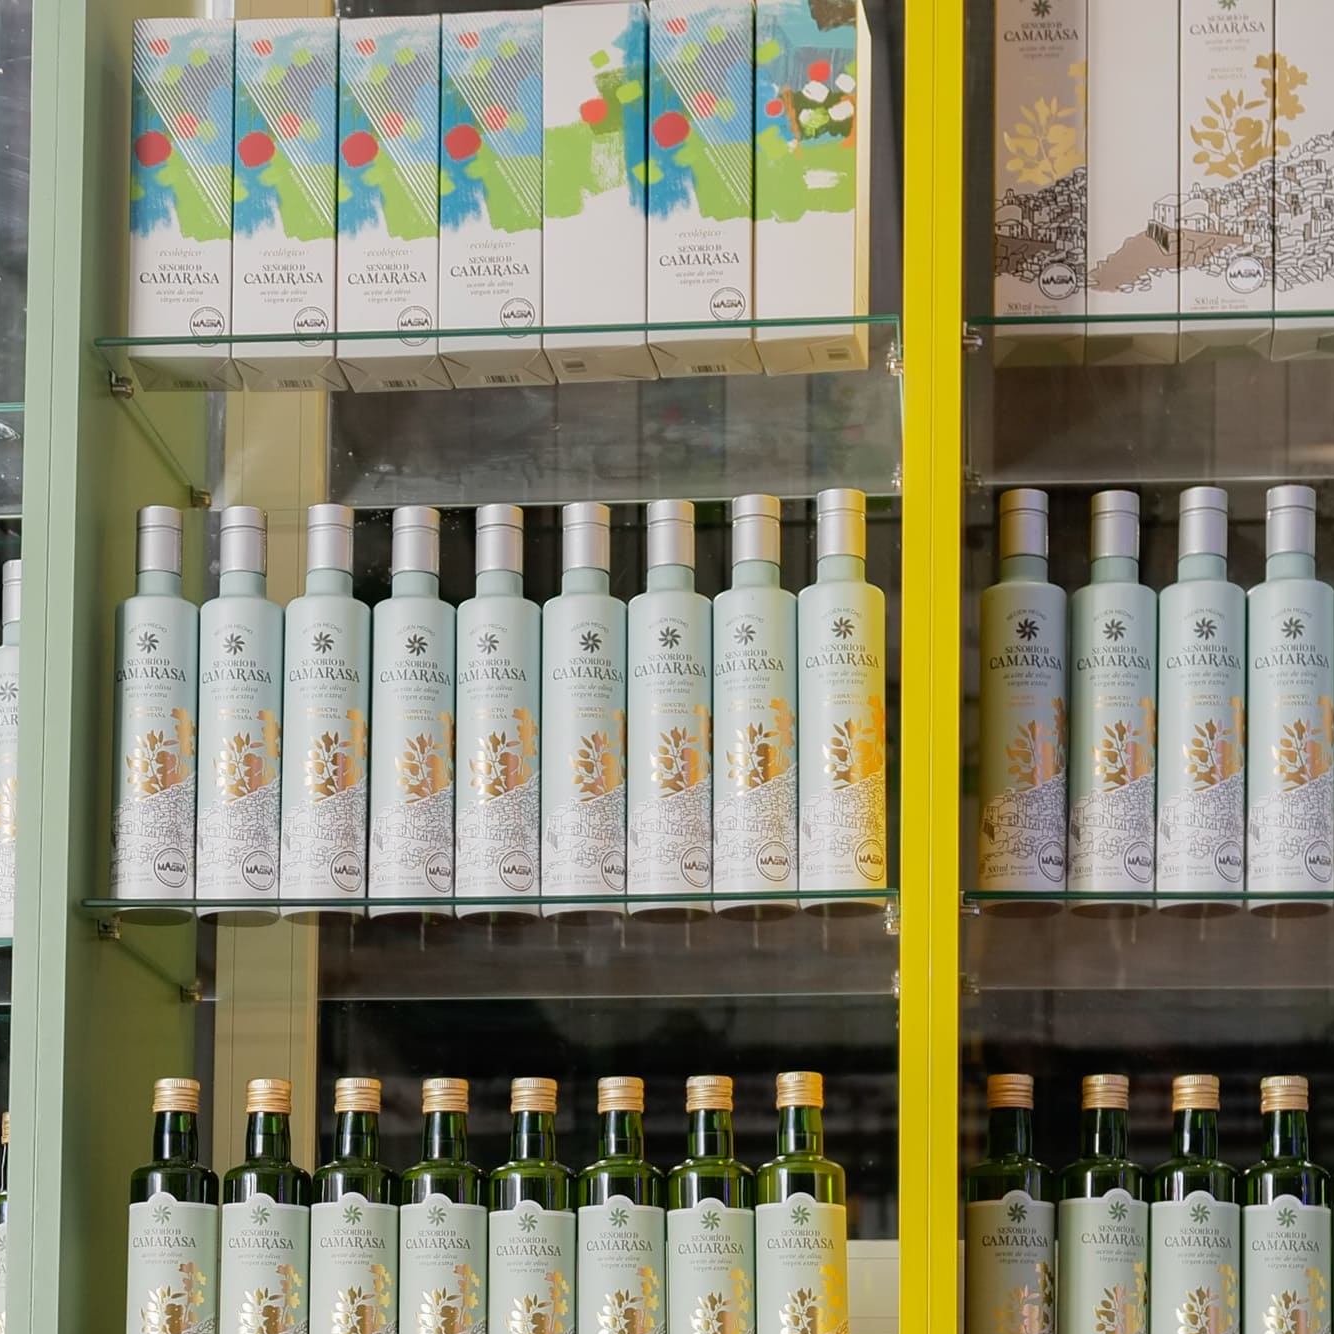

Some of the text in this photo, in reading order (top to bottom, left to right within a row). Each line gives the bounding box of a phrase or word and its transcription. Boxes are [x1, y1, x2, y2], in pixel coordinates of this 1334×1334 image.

[1003, 28, 1079, 42] CAMARASA
[1189, 21, 1265, 36] CAMARASA
[659, 252, 739, 268] CAMARASA
[139, 271, 219, 285] CAMARASA
[243, 271, 324, 284] CAMARASA
[347, 270, 427, 285] CAMARASA
[450, 263, 530, 278] CAMARASA
[805, 653, 880, 669] CAMARASA
[989, 654, 1062, 671] CAMARASA
[1077, 655, 1151, 672] CAMARASA
[1166, 654, 1241, 671] CAMARASA
[1254, 654, 1330, 671] CAMARASA
[202, 669, 272, 685] CAMARASA
[289, 668, 360, 684] CAMARASA
[380, 670, 451, 686] CAMARASA
[553, 668, 624, 683] CAMARASA
[633, 664, 707, 680] CAMARASA
[133, 1236, 196, 1249] CAMARASA
[228, 1238, 295, 1251] CAMARASA
[319, 1236, 385, 1250] CAMARASA
[405, 1237, 471, 1251] CAMARASA
[587, 1239, 653, 1253] CAMARASA
[767, 1237, 834, 1251] CAMARASA
[982, 1234, 1048, 1248] CAMARASA
[1081, 1232, 1145, 1247] CAMARASA
[1164, 1236, 1232, 1249] CAMARASA
[1252, 1239, 1321, 1253] CAMARASA
[496, 1244, 562, 1257] CAMARASA
[678, 1243, 744, 1256] CAMARASA
